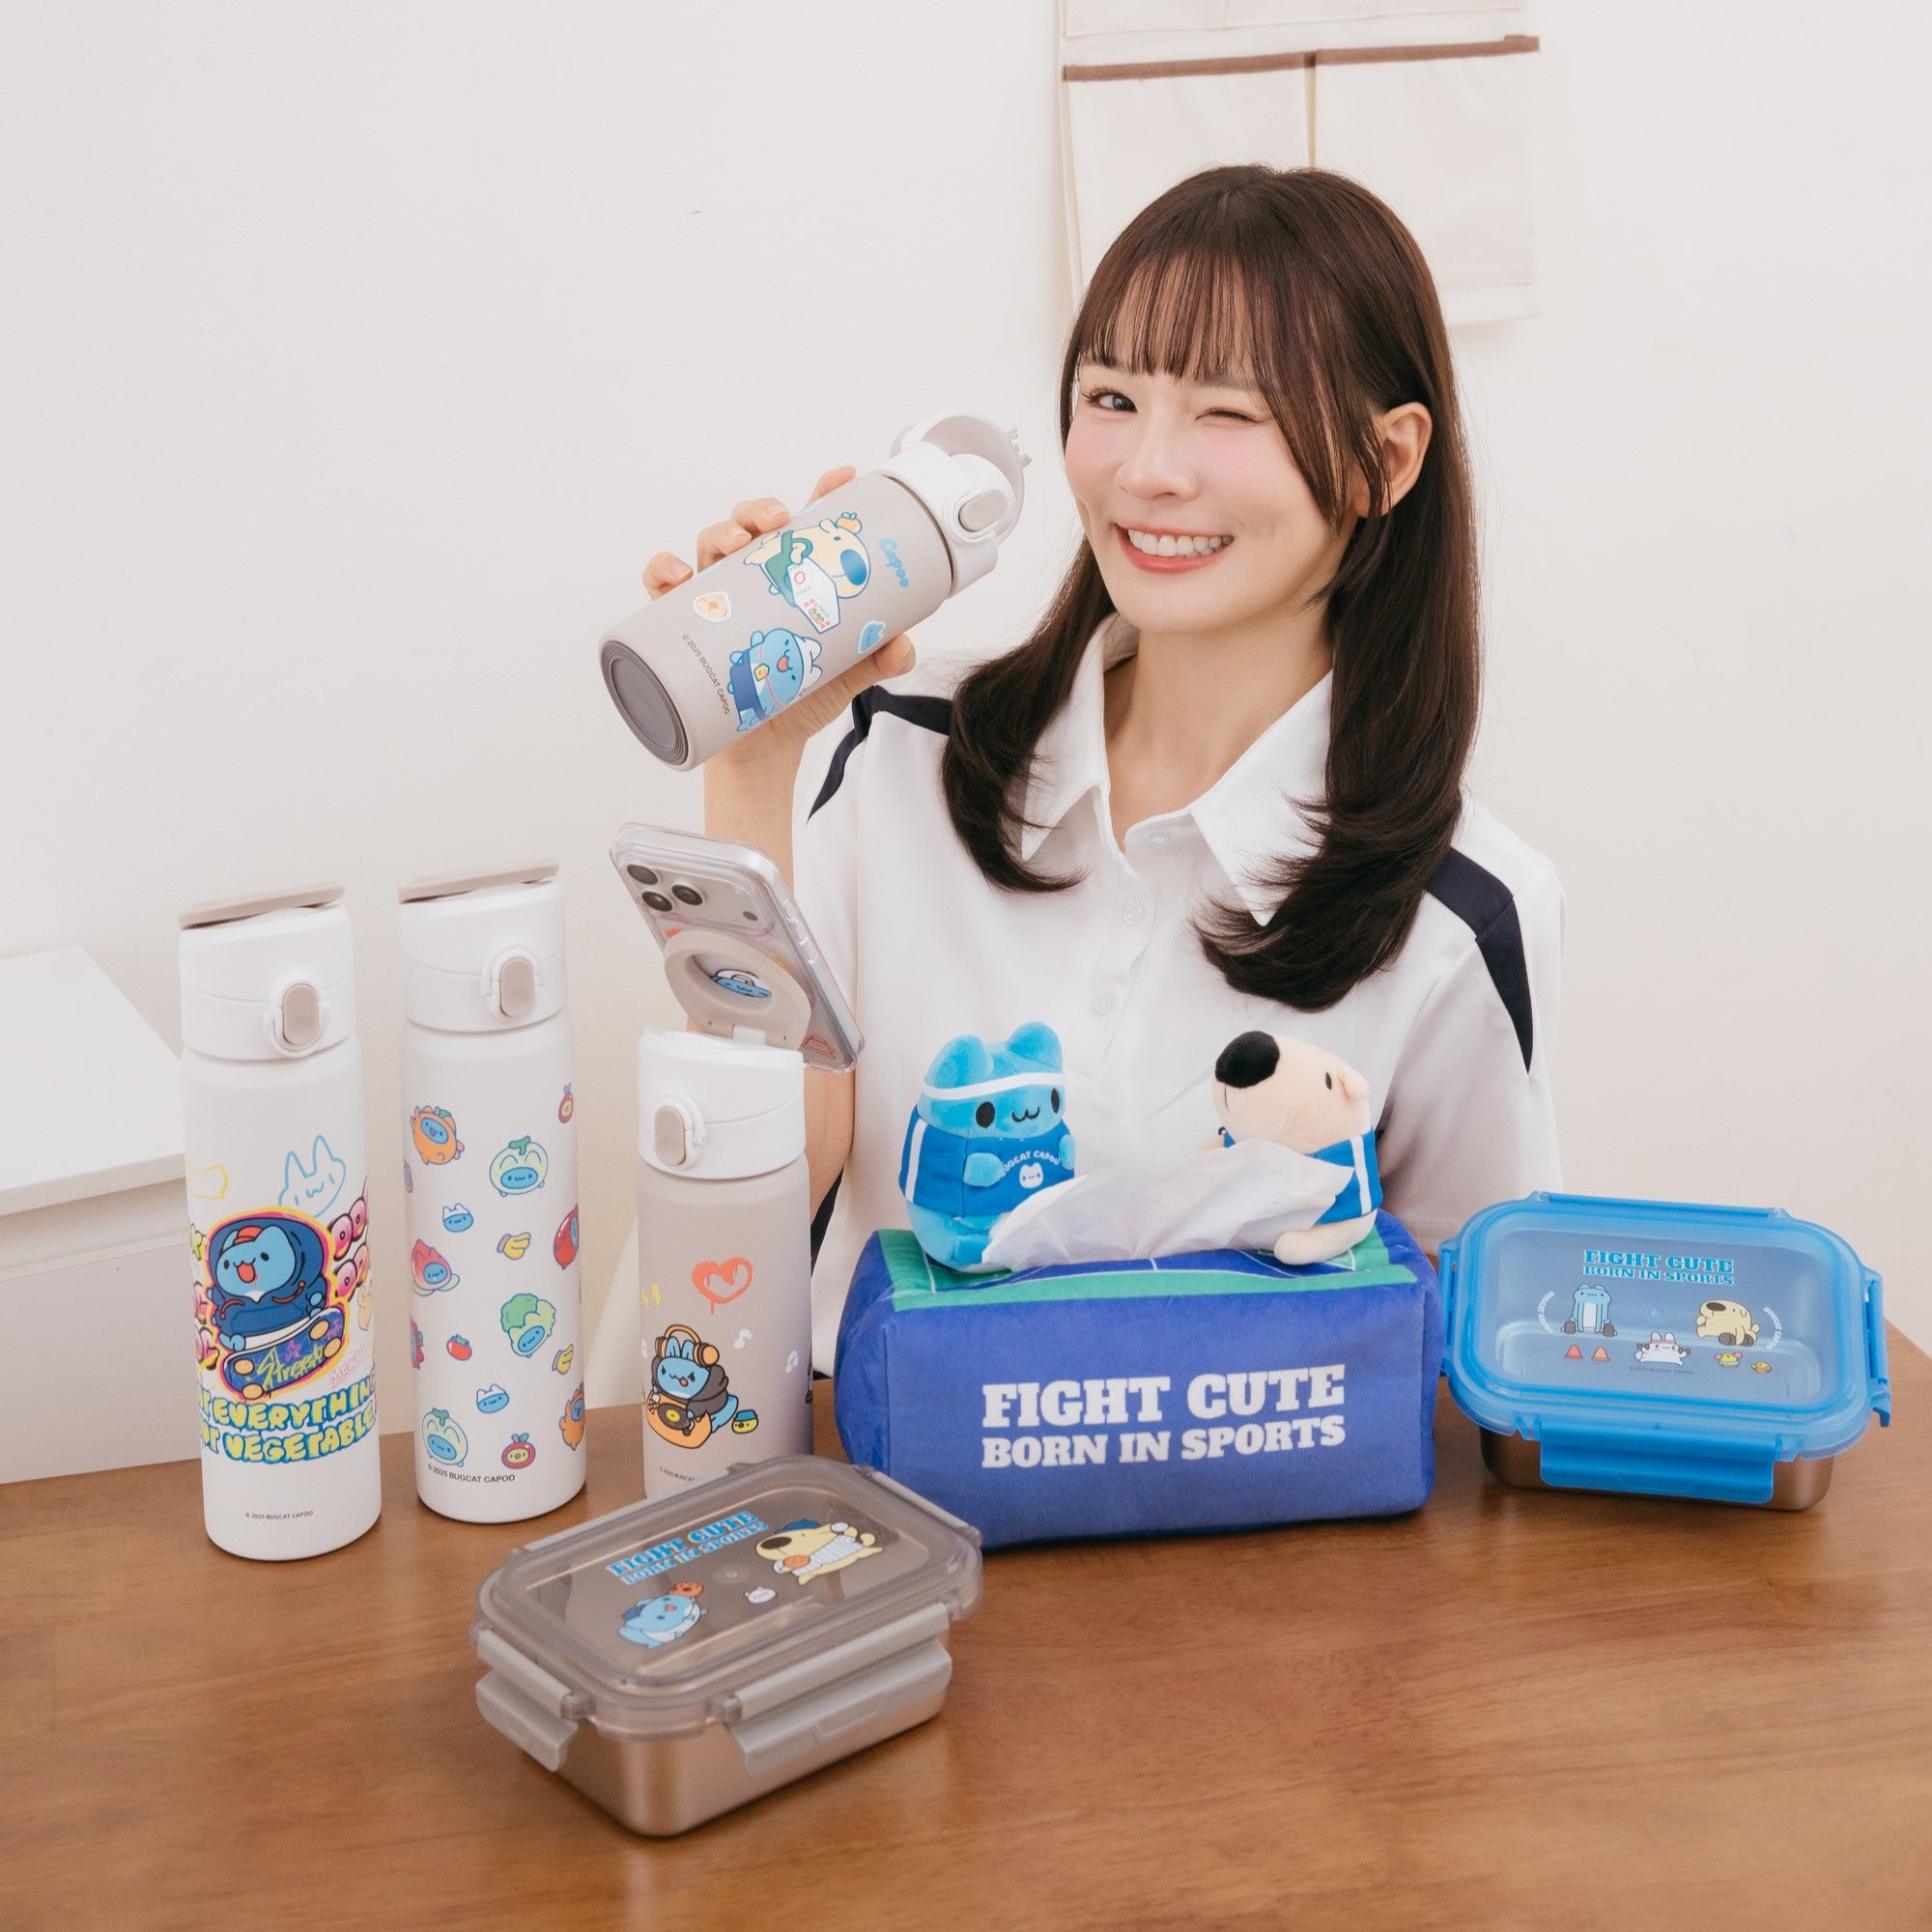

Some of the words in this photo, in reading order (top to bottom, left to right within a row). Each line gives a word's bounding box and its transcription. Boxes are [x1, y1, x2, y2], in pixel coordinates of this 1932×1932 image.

[879, 538, 909, 587] Capoo
[687, 640, 702, 657] 2025
[699, 657, 721, 688] BUGCAT
[717, 688, 730, 715] CAPOO
[1002, 1151, 1032, 1177] UGCAT
[1033, 1150, 1060, 1165] CAPOO
[1583, 1250, 1661, 1268] FIGHT
[1666, 1255, 1734, 1273] CUTE
[1583, 1265, 1635, 1278] BORN
[1638, 1269, 1662, 1280] IN
[1663, 1272, 1734, 1287] SPORTS
[257, 1344, 325, 1391] Street
[982, 1377, 1171, 1428] FIGHT
[1187, 1364, 1345, 1419] CUTE
[982, 1435, 1108, 1467] BORN
[1120, 1431, 1171, 1463] IN
[1181, 1415, 1346, 1461] SPORTS
[433, 1466, 448, 1477] 2025
[449, 1471, 481, 1483] BUGCAT
[483, 1474, 516, 1483] CAPOO
[292, 1510, 314, 1519] CAPOO
[606, 1537, 687, 1577] FIGHT
[688, 1510, 758, 1544] CUTE
[620, 1557, 677, 1585] BORN
[673, 1548, 701, 1564] IN
[698, 1520, 769, 1553] SPORTS
